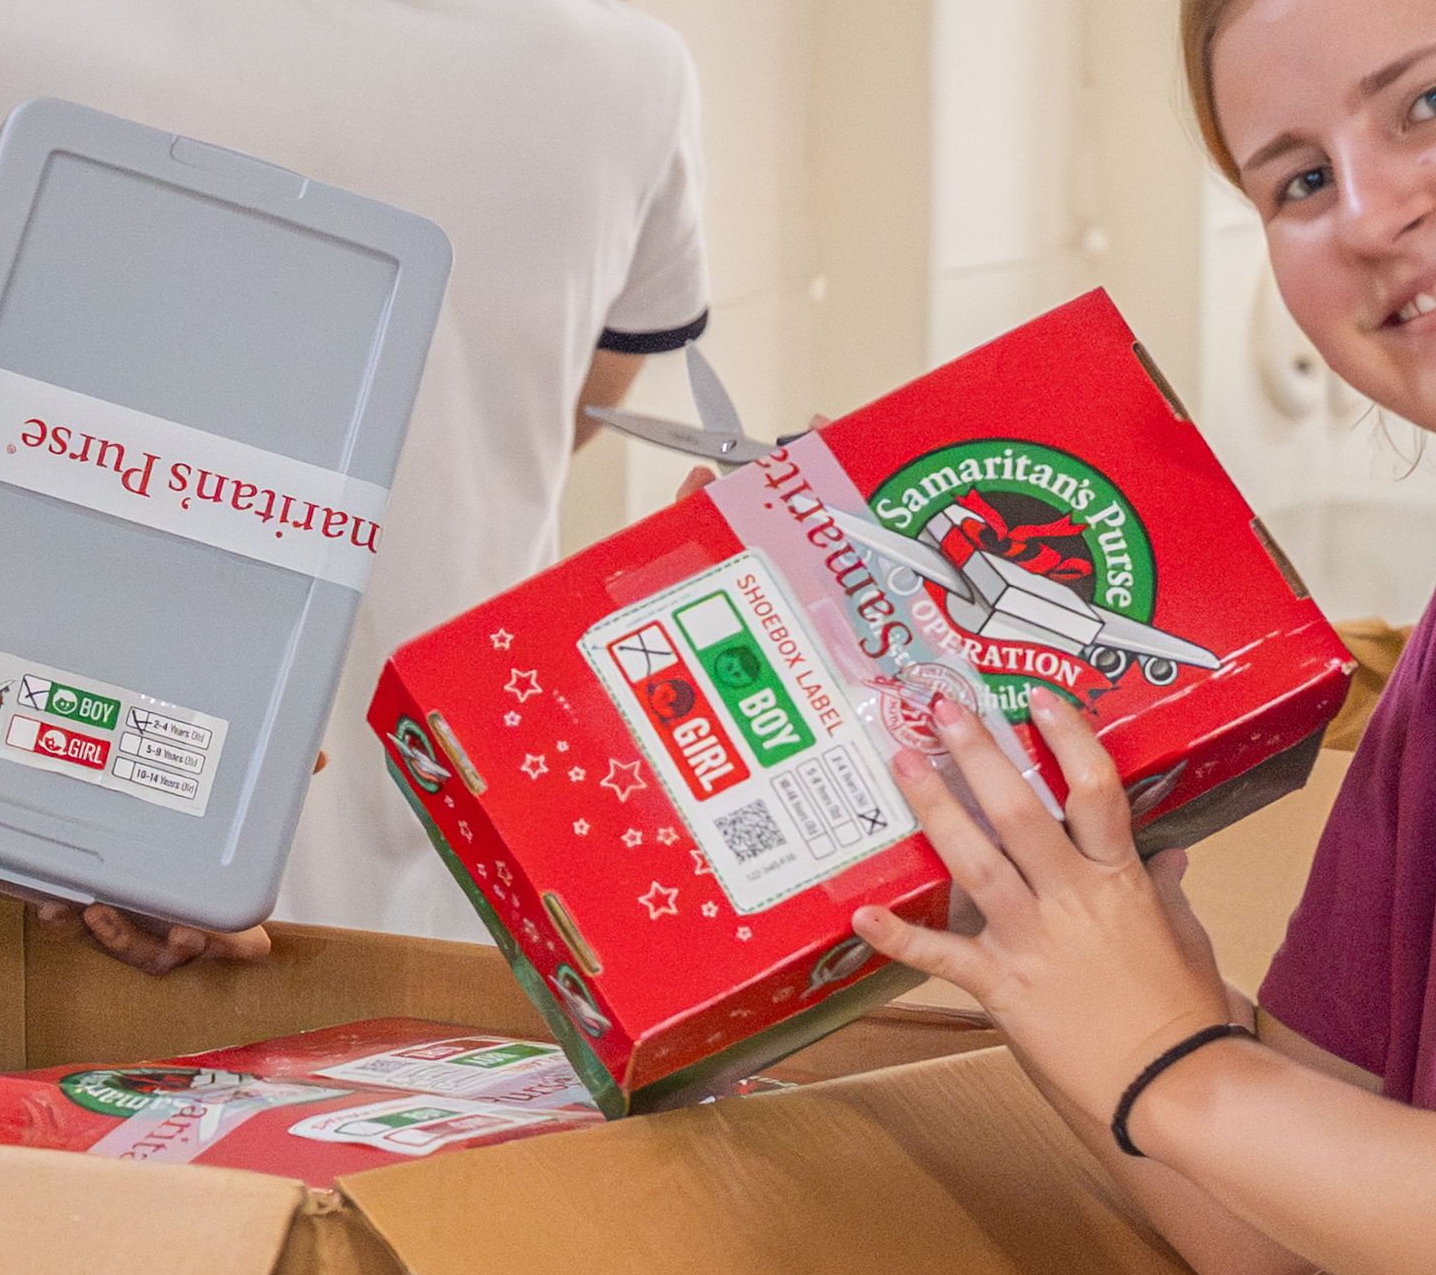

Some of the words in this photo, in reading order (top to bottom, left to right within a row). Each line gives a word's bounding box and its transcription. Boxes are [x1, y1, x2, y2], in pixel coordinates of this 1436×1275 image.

[20, 417, 162, 499] Purse
[877, 448, 1096, 529] Samaritan's
[1085, 499, 1136, 609] Purse
[736, 573, 806, 670] SHOEBOX
[795, 669, 844, 738] LABEL
[911, 599, 1082, 689] OPERATION
[79, 698, 115, 723] BOY
[738, 687, 801, 750] BOY
[66, 740, 104, 765] GIRL
[672, 717, 734, 792] GIRL
